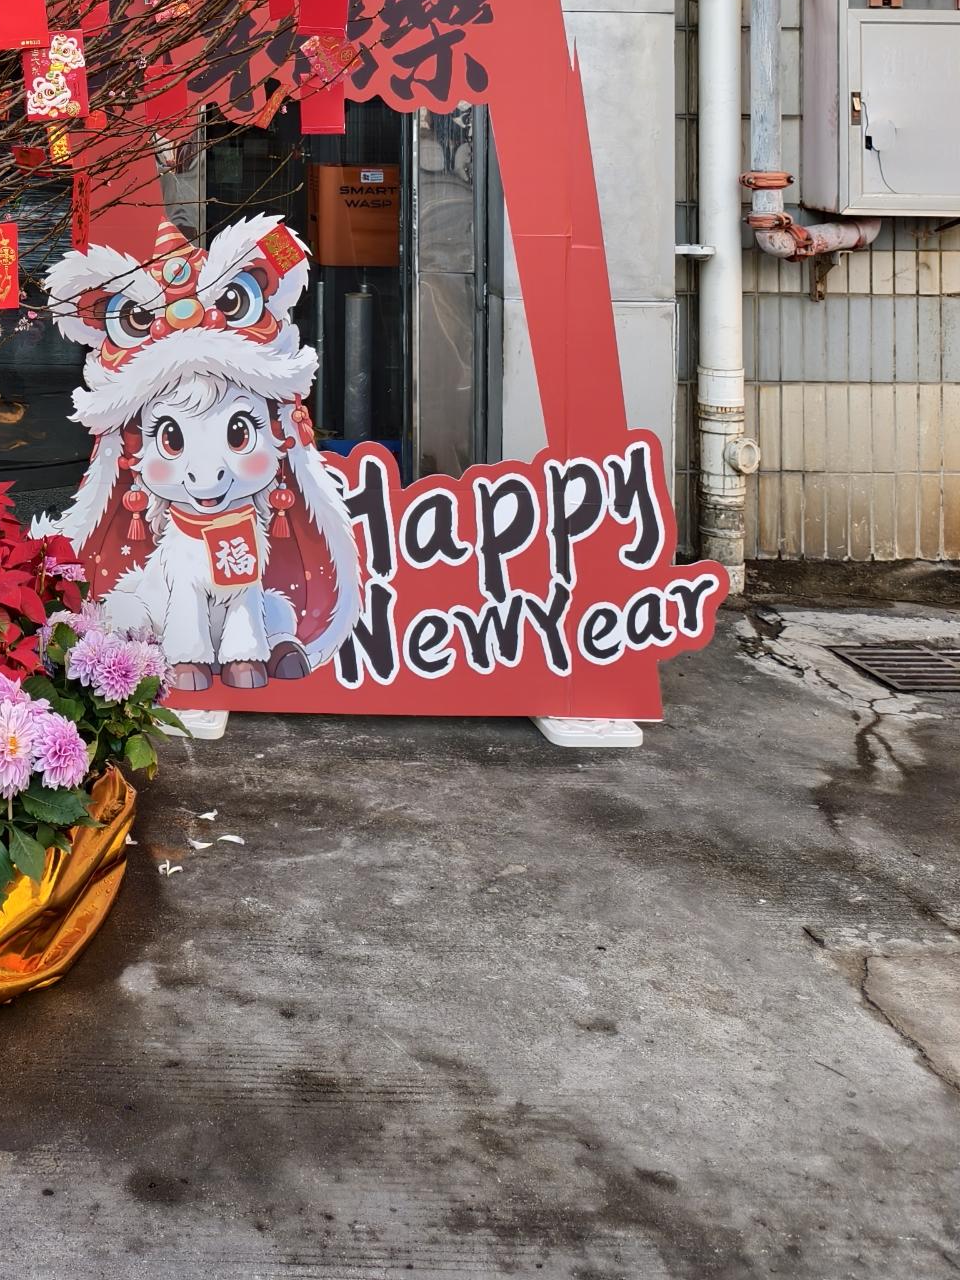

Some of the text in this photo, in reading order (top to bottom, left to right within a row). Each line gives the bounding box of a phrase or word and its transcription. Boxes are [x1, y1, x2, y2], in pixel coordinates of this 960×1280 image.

[339, 185, 398, 195] SMART
[326, 447, 661, 603] Happy
[216, 536, 257, 578] 福
